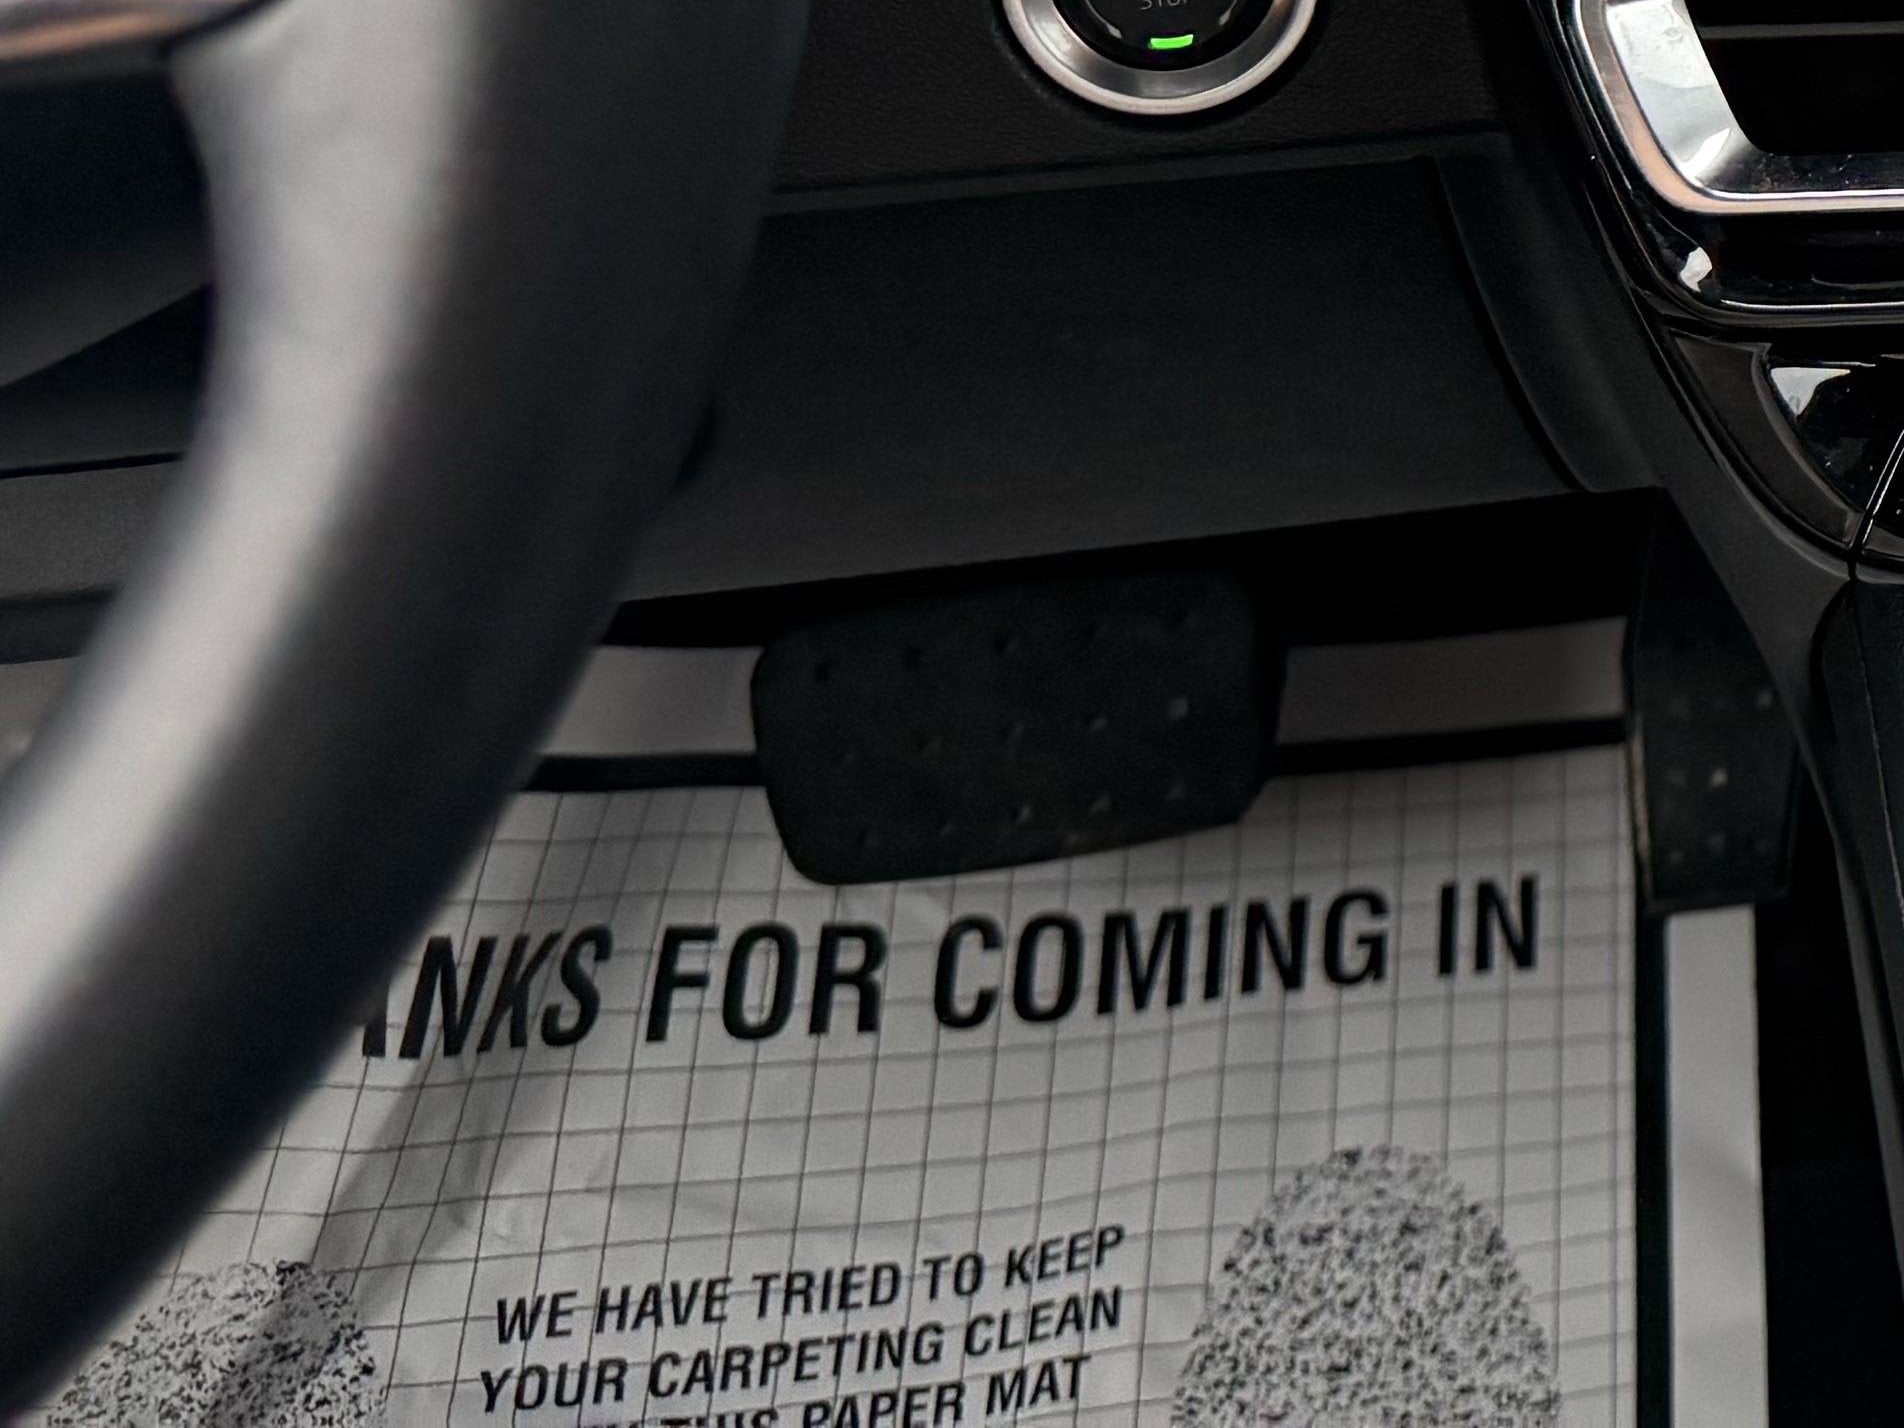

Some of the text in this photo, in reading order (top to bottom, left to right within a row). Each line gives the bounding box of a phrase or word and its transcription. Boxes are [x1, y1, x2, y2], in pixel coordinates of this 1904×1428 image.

[644, 919, 888, 1042] FOR
[932, 888, 1392, 1030] COMING
[1436, 873, 1541, 978] IN
[496, 1223, 1125, 1345] WE HAVE TRIED TO KEEP
[480, 1285, 1122, 1414] YOUR CARPETING CLEAN
[986, 1354, 1092, 1416] MAT
